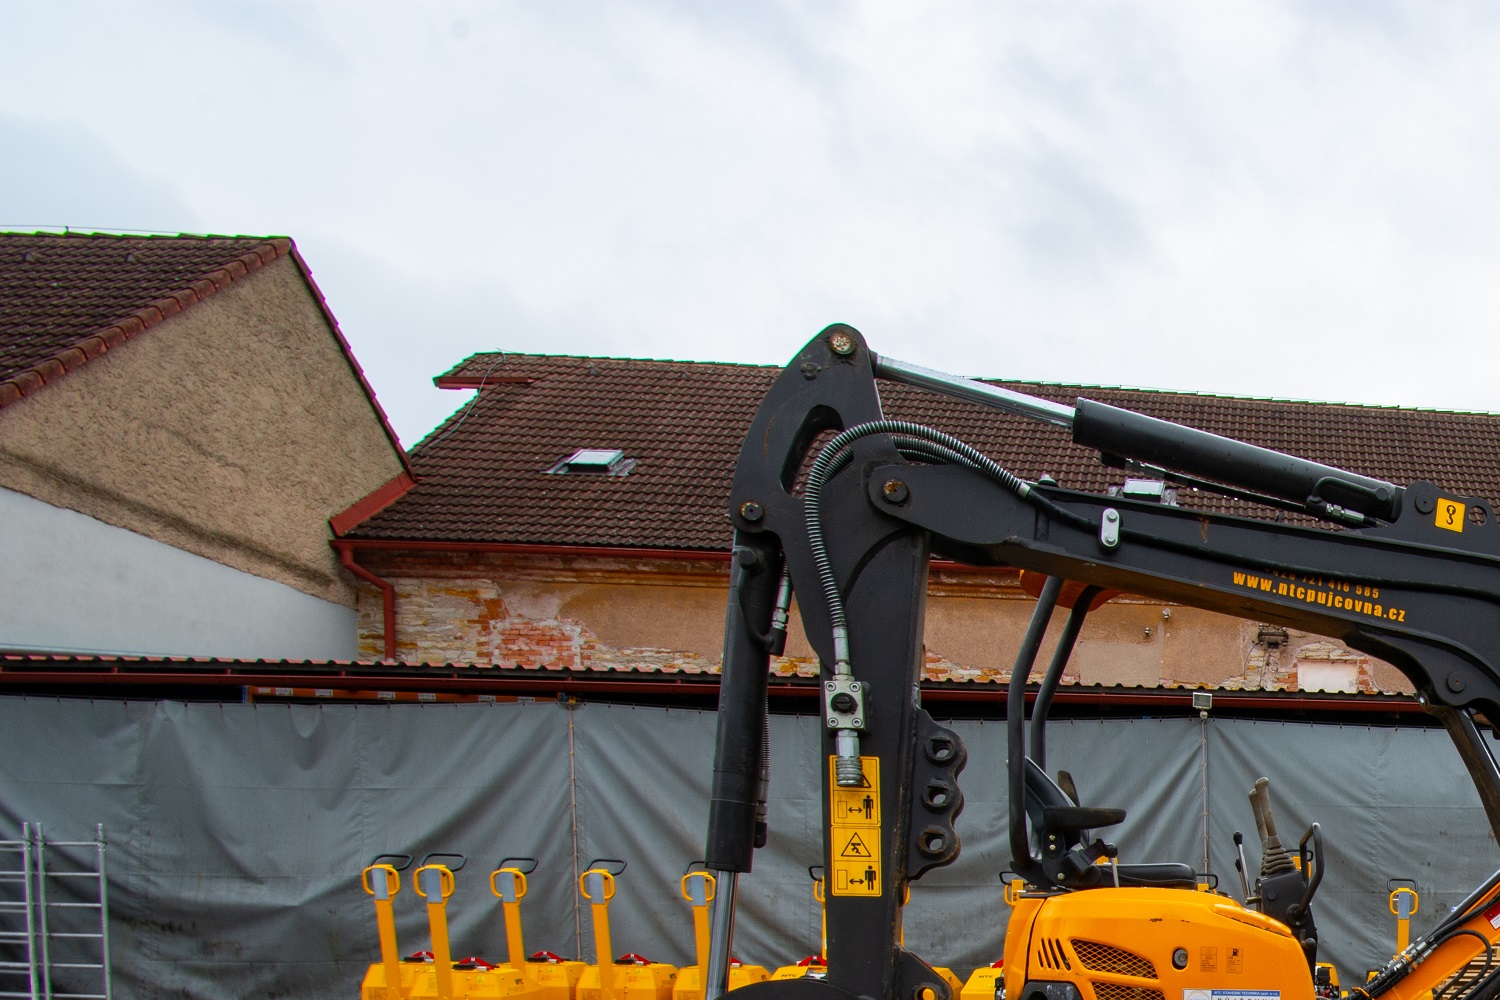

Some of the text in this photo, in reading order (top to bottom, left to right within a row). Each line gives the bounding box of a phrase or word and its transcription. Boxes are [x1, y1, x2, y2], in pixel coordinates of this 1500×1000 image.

[1232, 570, 1406, 623] www.ntcpujcovna.cz
[1327, 579, 1350, 593] 416
[1355, 584, 1379, 599] 585
